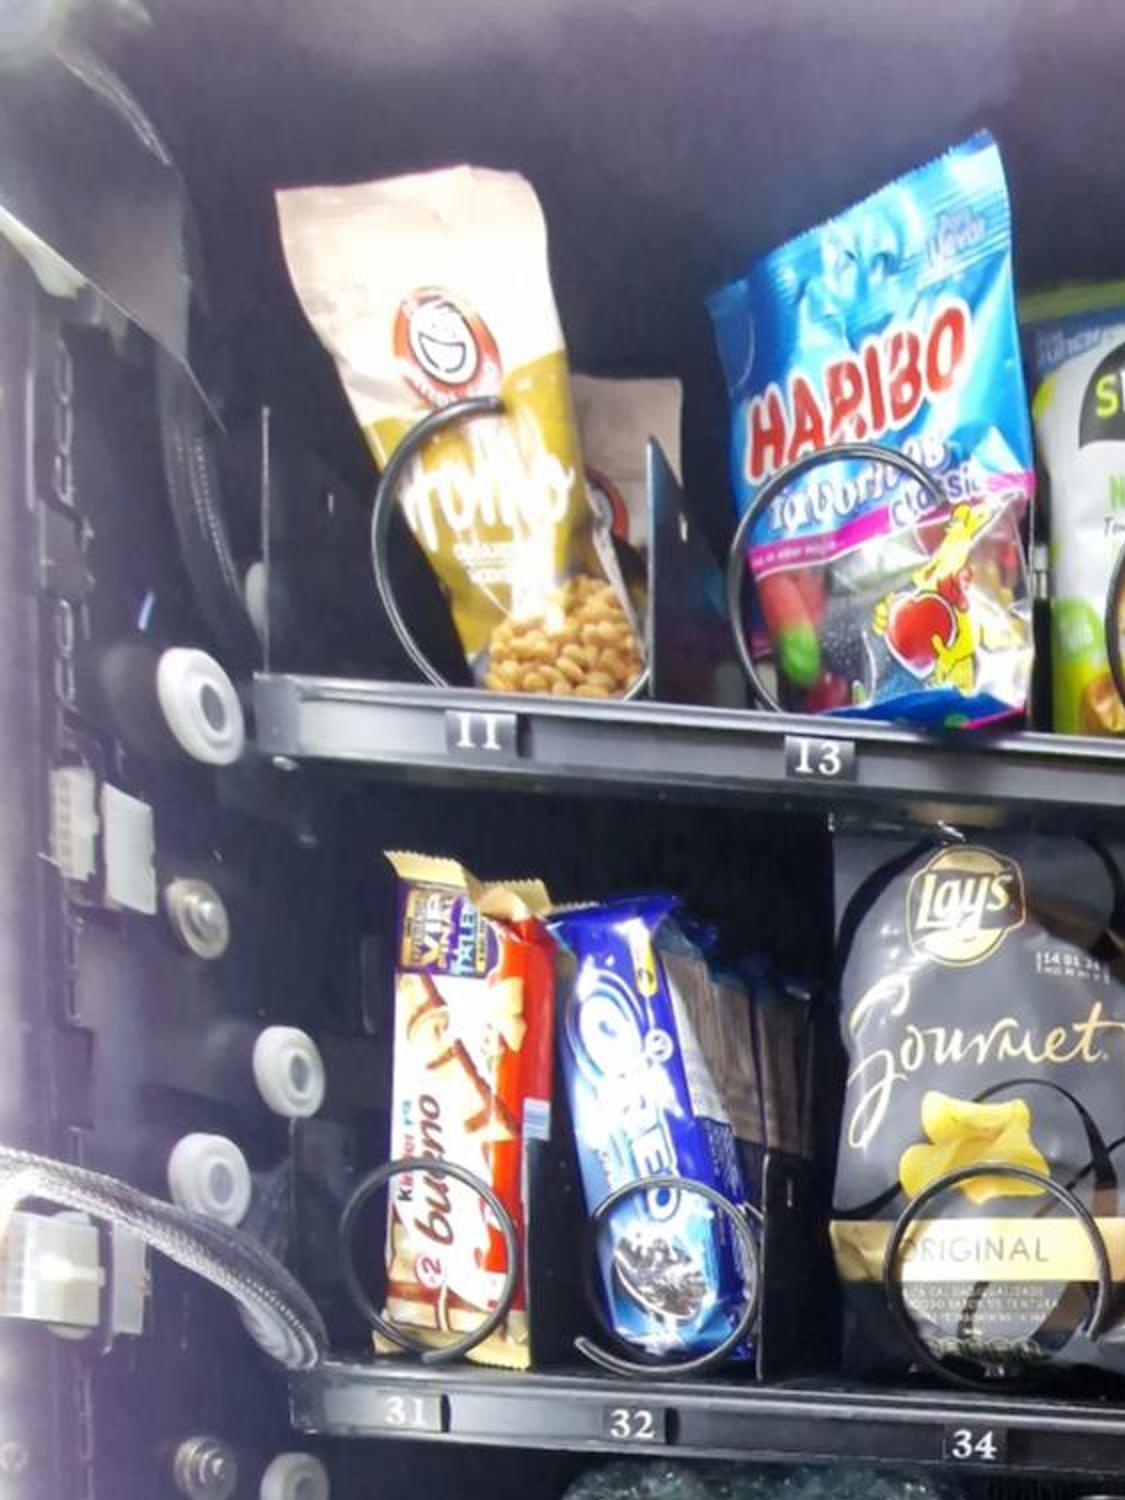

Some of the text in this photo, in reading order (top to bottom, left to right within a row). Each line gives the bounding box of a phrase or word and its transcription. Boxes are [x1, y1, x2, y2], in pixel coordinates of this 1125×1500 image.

[745, 306, 967, 481] HARIBO
[456, 712, 501, 751] 11
[794, 739, 842, 776] 13
[385, 1396, 427, 1427] 31
[609, 1410, 656, 1441] 32
[951, 1430, 997, 1461] 34
